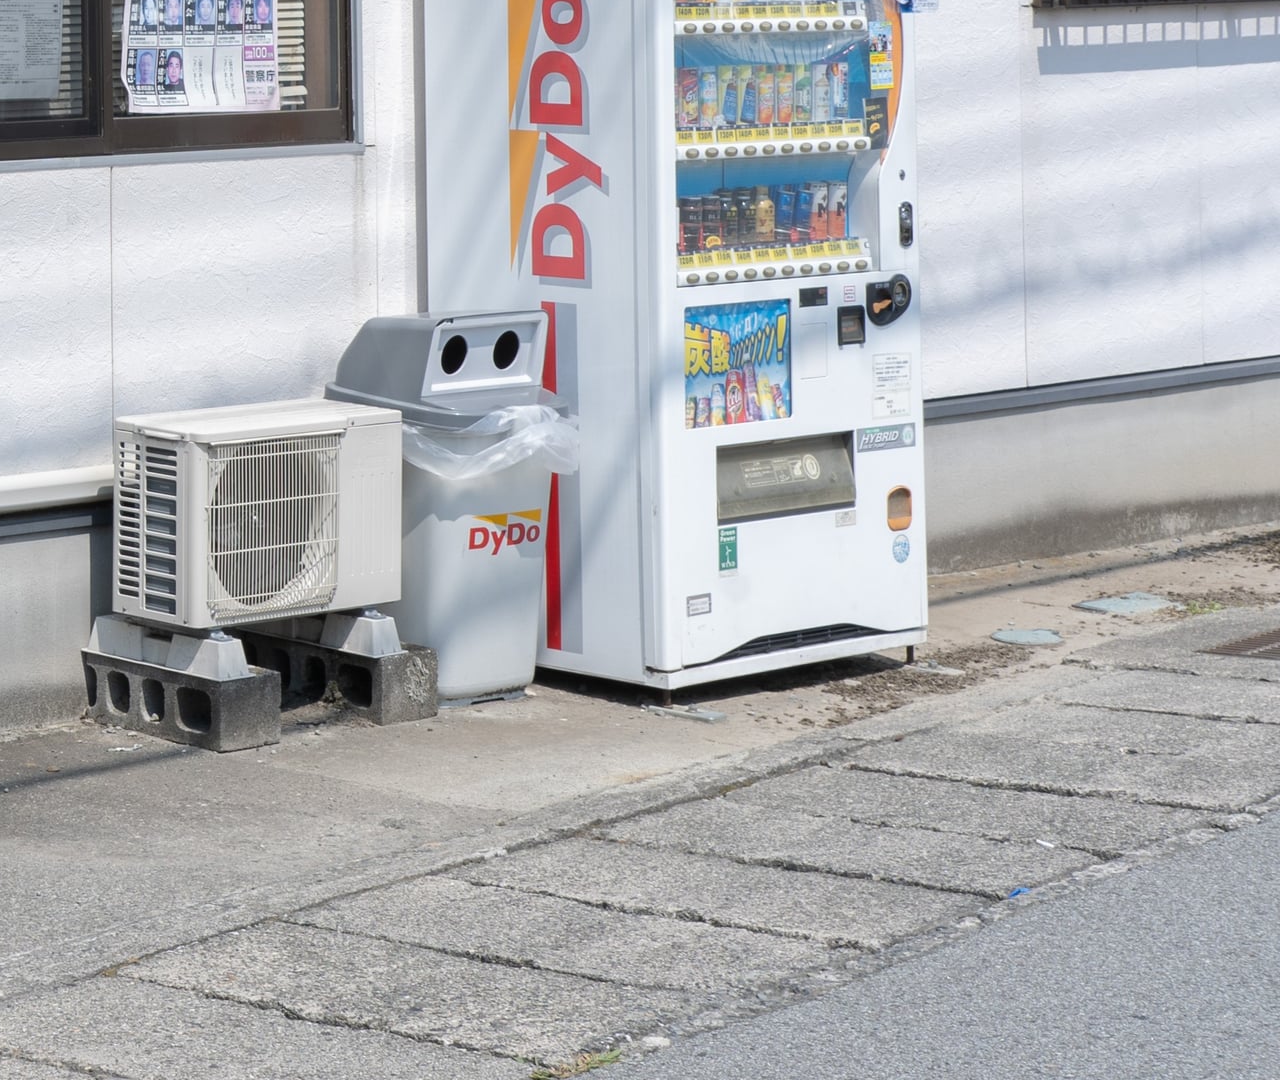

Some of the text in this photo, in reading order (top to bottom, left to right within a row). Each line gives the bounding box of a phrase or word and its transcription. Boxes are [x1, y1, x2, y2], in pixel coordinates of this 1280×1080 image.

[245, 70, 276, 83] 警察庁
[861, 430, 899, 445] HYBRID
[468, 522, 540, 556] DyDo
